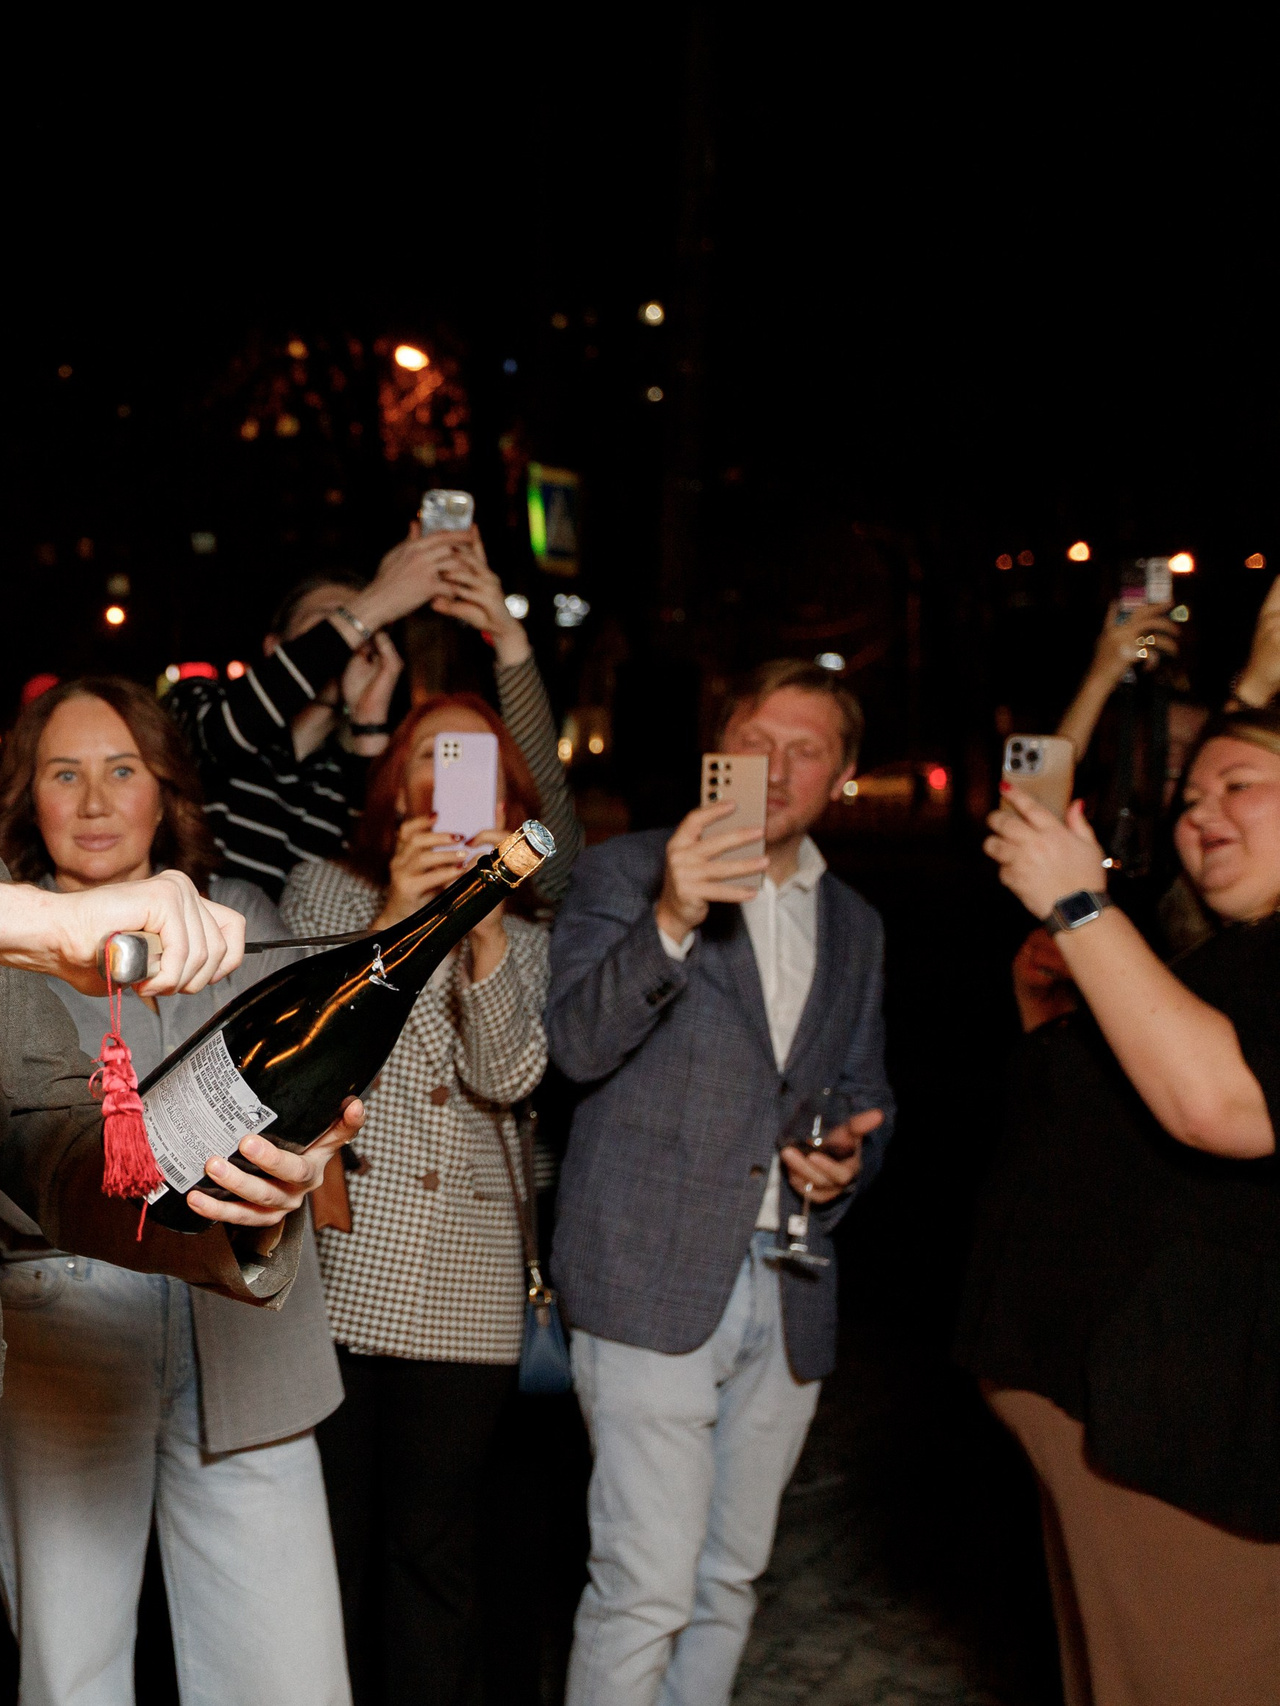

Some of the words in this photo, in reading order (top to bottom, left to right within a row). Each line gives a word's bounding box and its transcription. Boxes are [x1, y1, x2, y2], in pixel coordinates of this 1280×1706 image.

[228, 1068, 239, 1082] 2019
[165, 1106, 185, 1135] ВАШЕМУ
[181, 1133, 208, 1162] ЗДОРОВЬ
[173, 1106, 199, 1142] УПОТРЕБЛЕНИЕ
